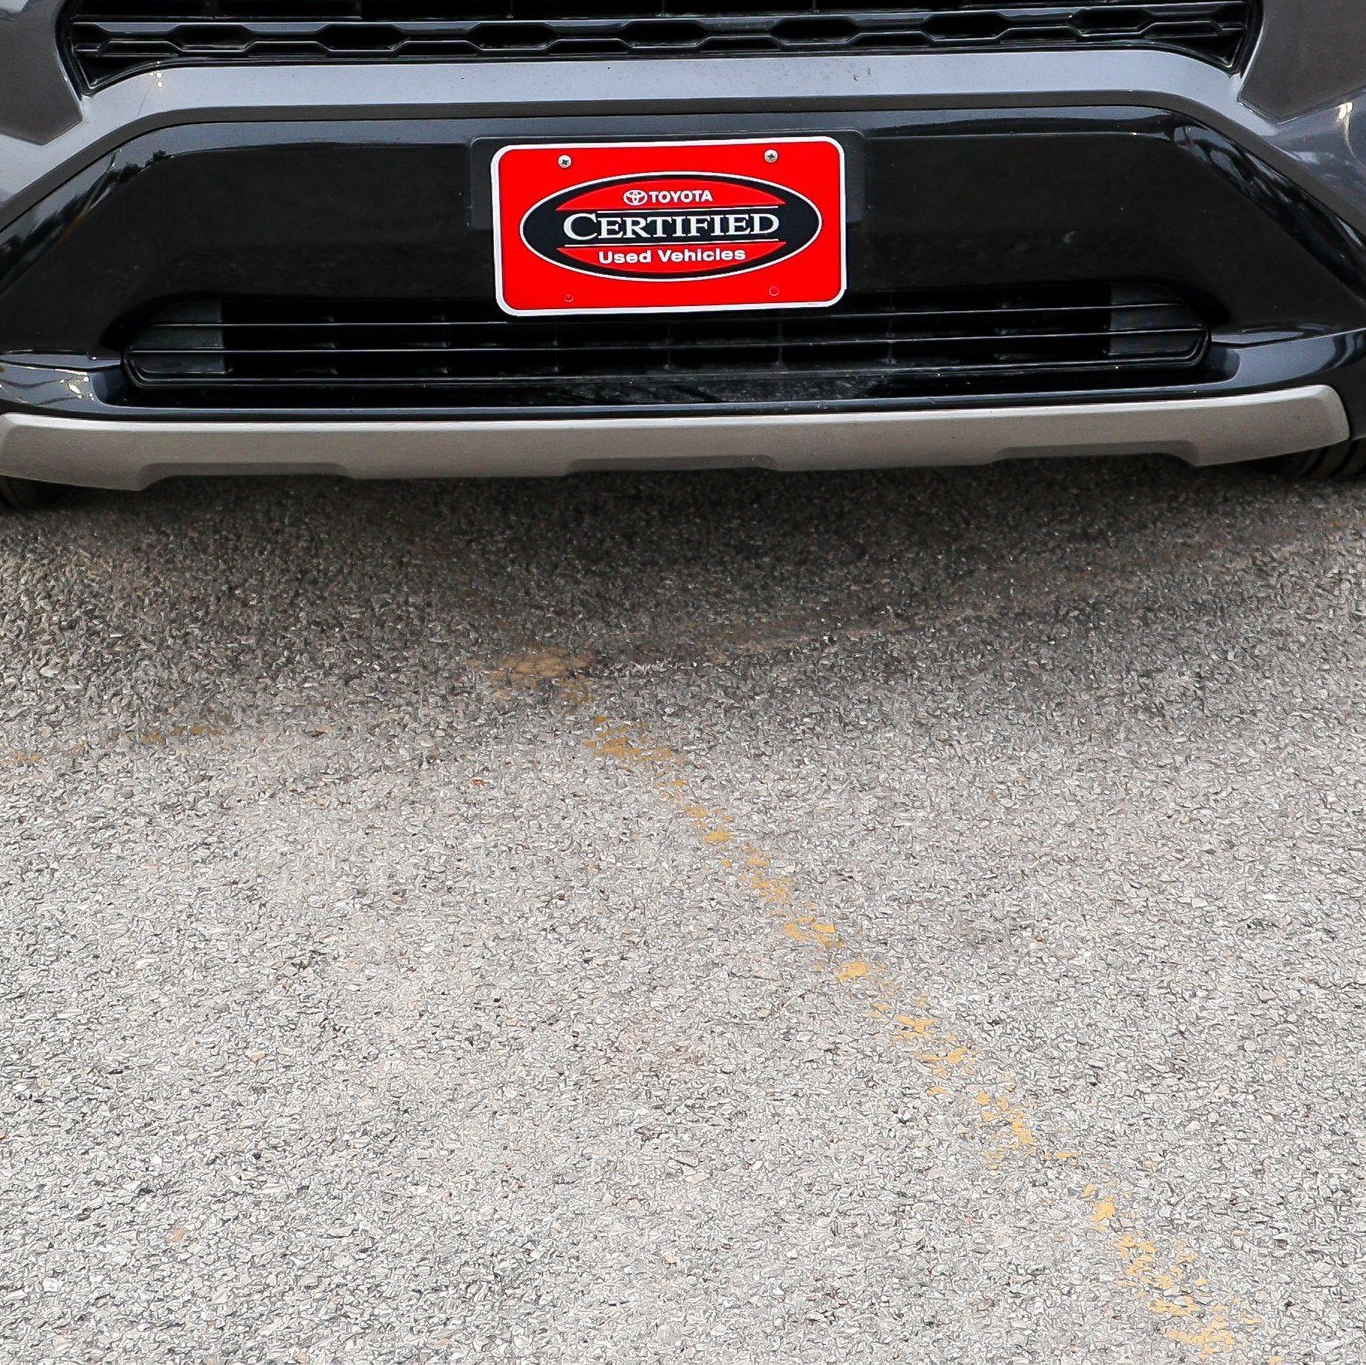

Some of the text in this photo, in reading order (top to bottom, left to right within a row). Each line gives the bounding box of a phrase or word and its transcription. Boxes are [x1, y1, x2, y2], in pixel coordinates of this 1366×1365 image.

[649, 189, 713, 204] TOYOTA
[563, 212, 780, 241] CERTIFIED
[598, 247, 746, 265] Used Vehicles
